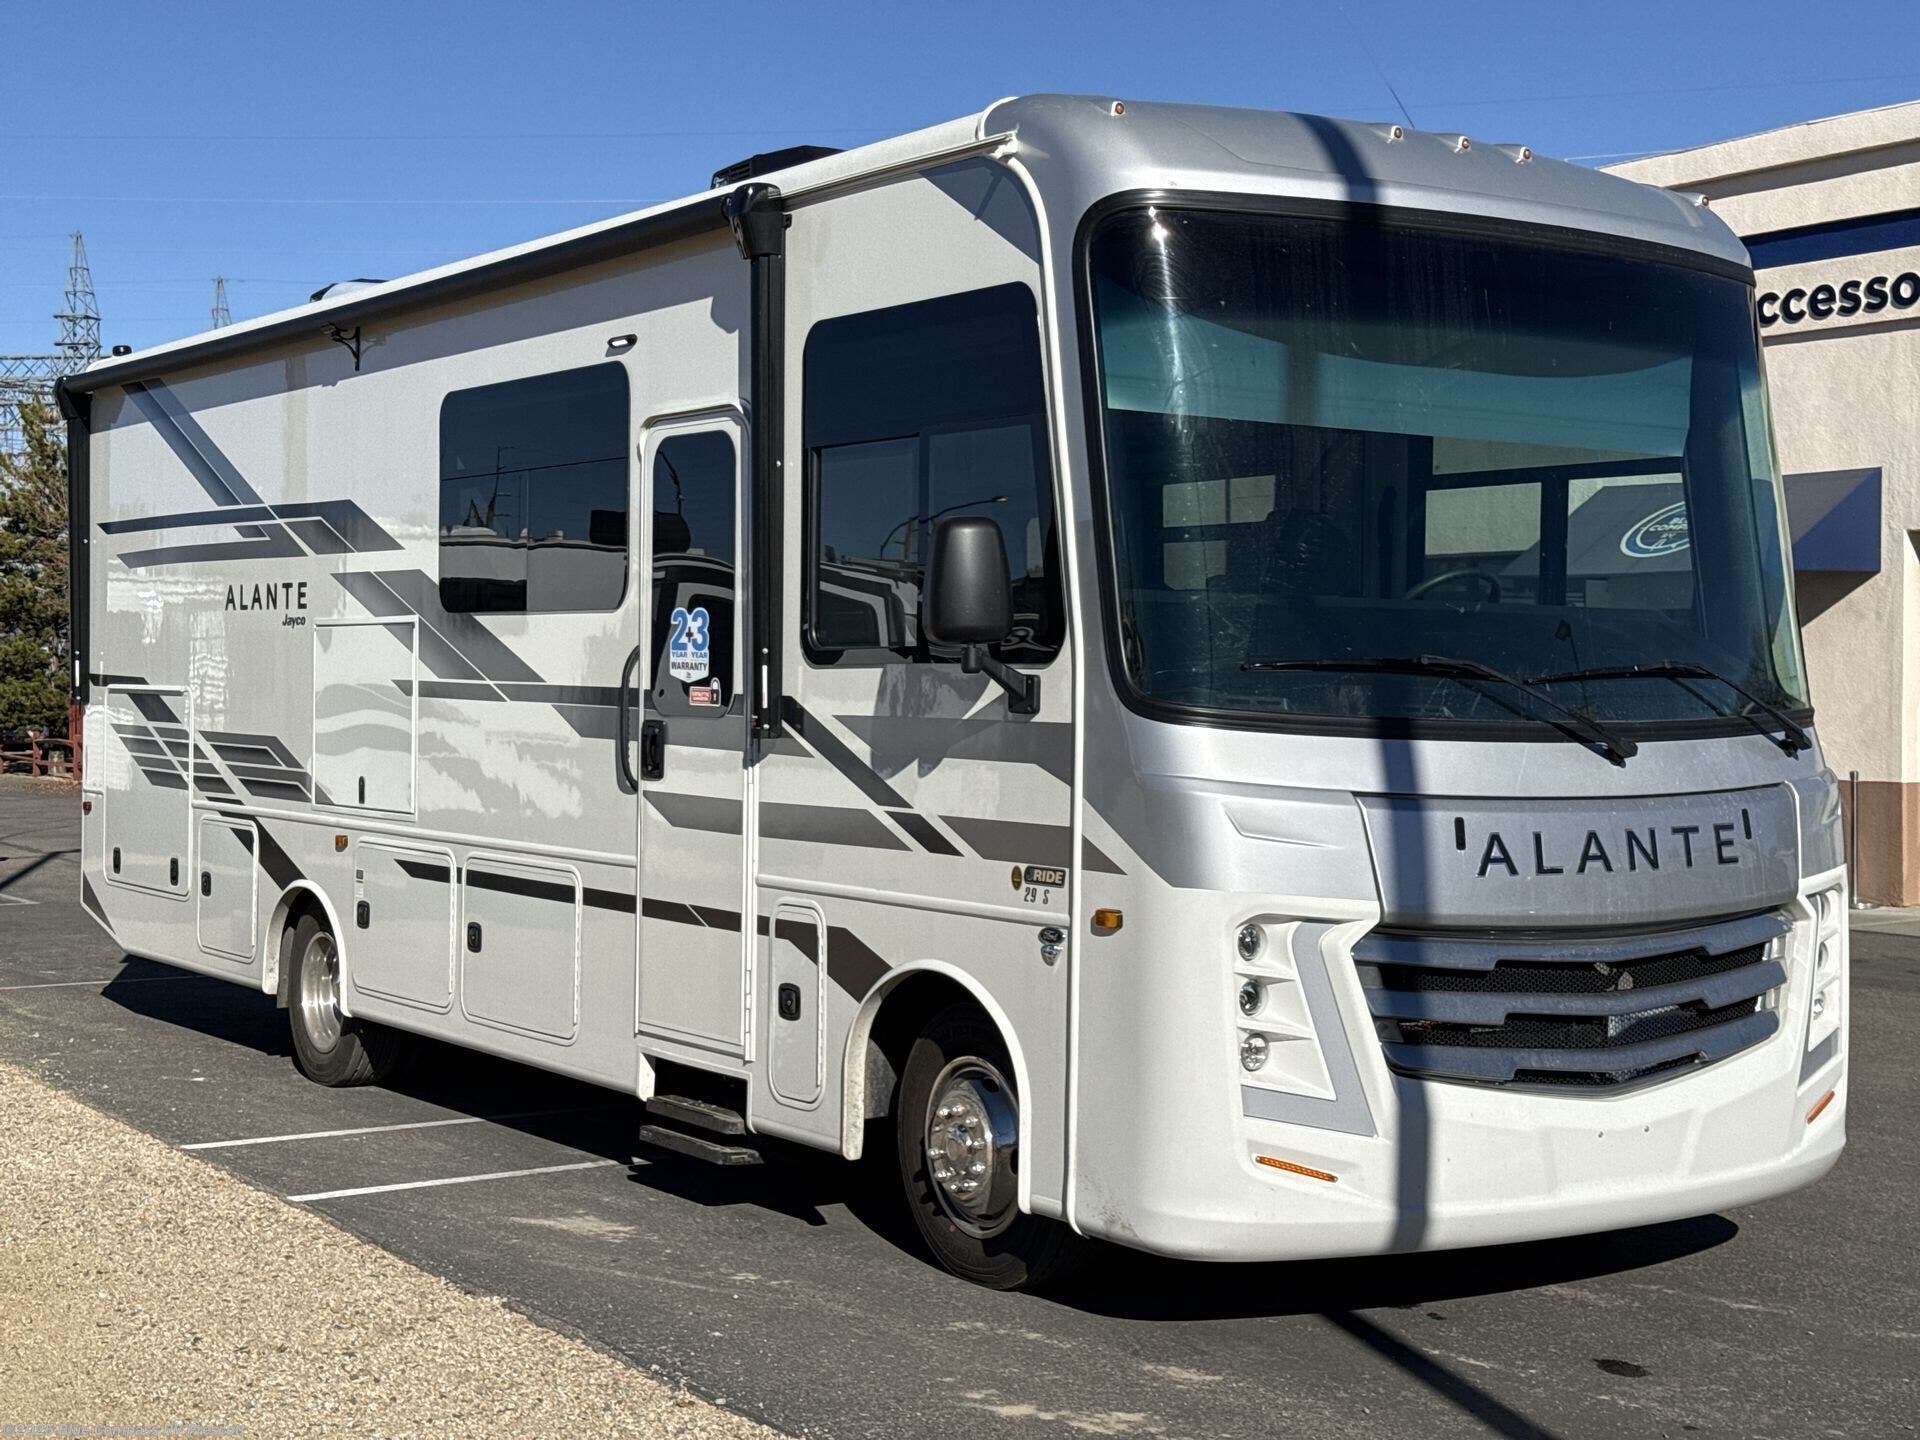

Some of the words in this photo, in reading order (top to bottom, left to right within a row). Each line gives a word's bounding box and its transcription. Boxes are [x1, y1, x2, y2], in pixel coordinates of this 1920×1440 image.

[224, 581, 308, 611] ALANTE
[282, 613, 306, 629] Jayco
[671, 661, 708, 671] WARRANTY
[1477, 822, 1740, 877] ALANTE
[1024, 886, 1038, 903] 29
[1042, 888, 1050, 905] S
